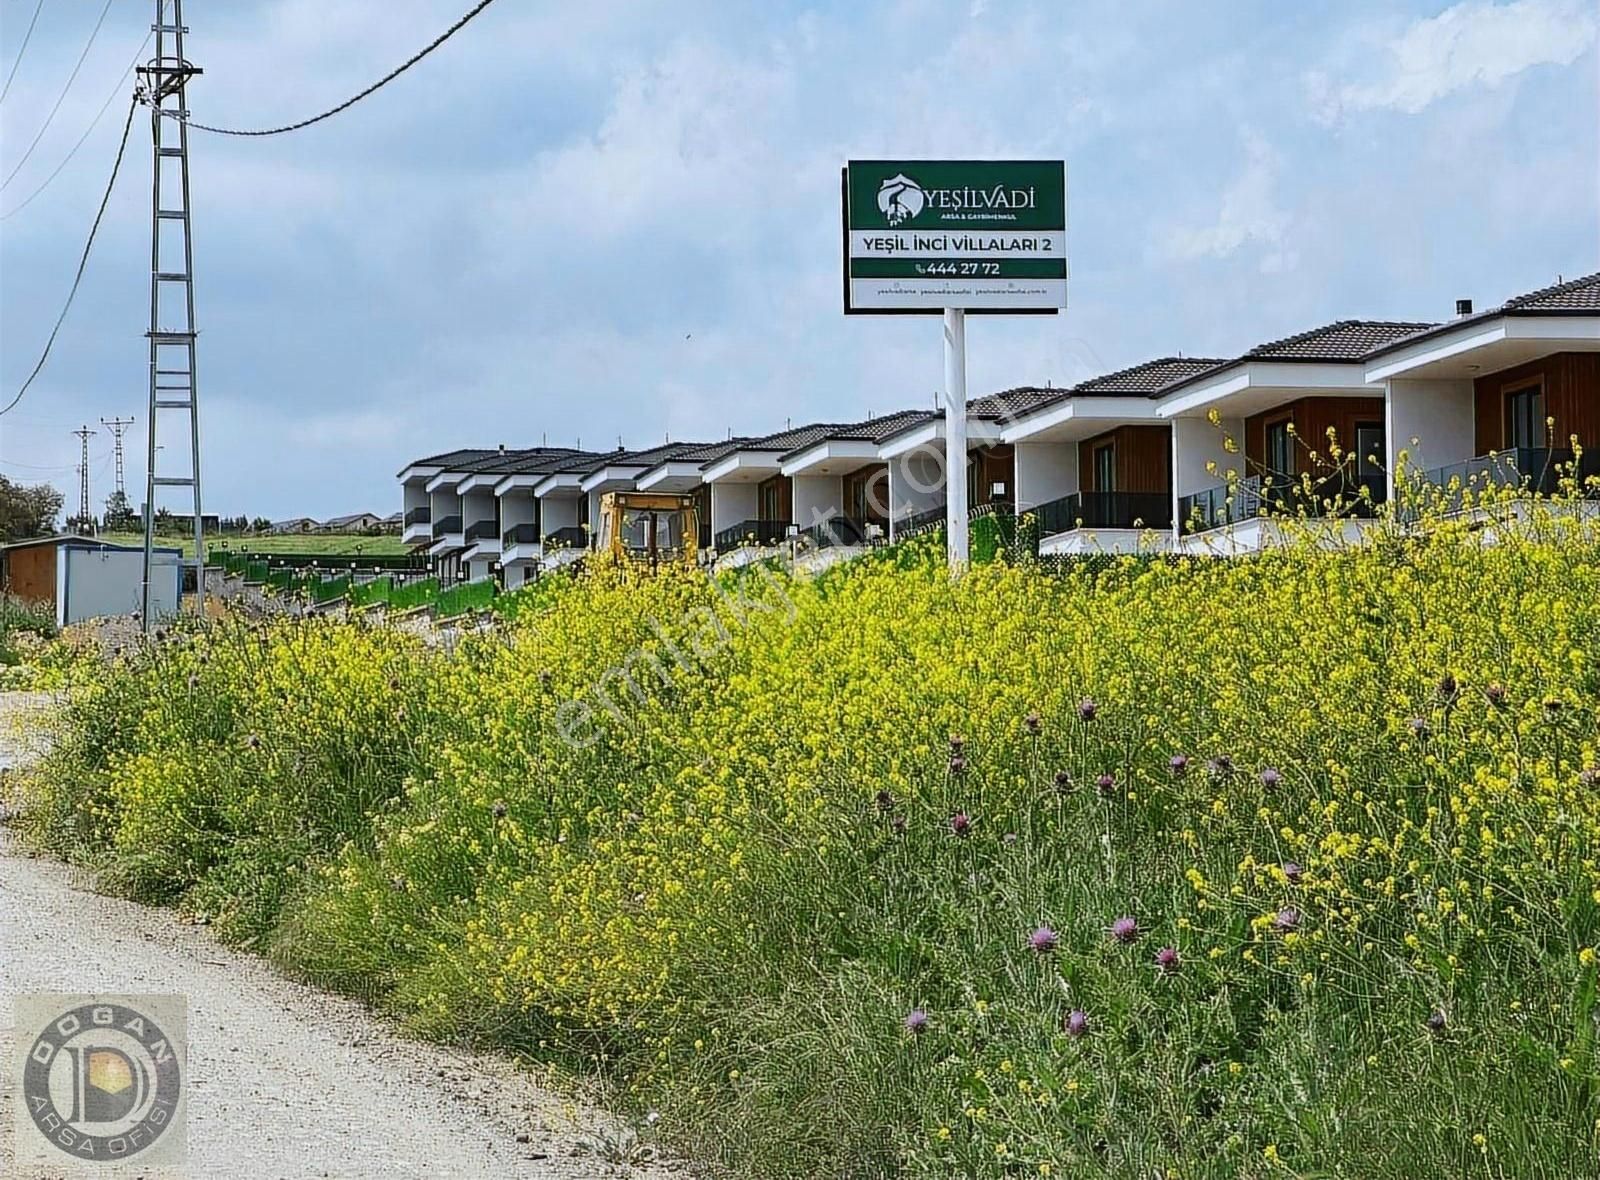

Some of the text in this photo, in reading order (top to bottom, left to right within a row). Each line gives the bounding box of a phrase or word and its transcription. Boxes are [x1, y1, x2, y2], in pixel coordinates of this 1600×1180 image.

[923, 185, 1035, 211] YEŞİLVADİ
[863, 235, 1052, 254] YEŞİL İNCİ VİLLALARI 2
[927, 263, 1000, 275] 444 27 72
